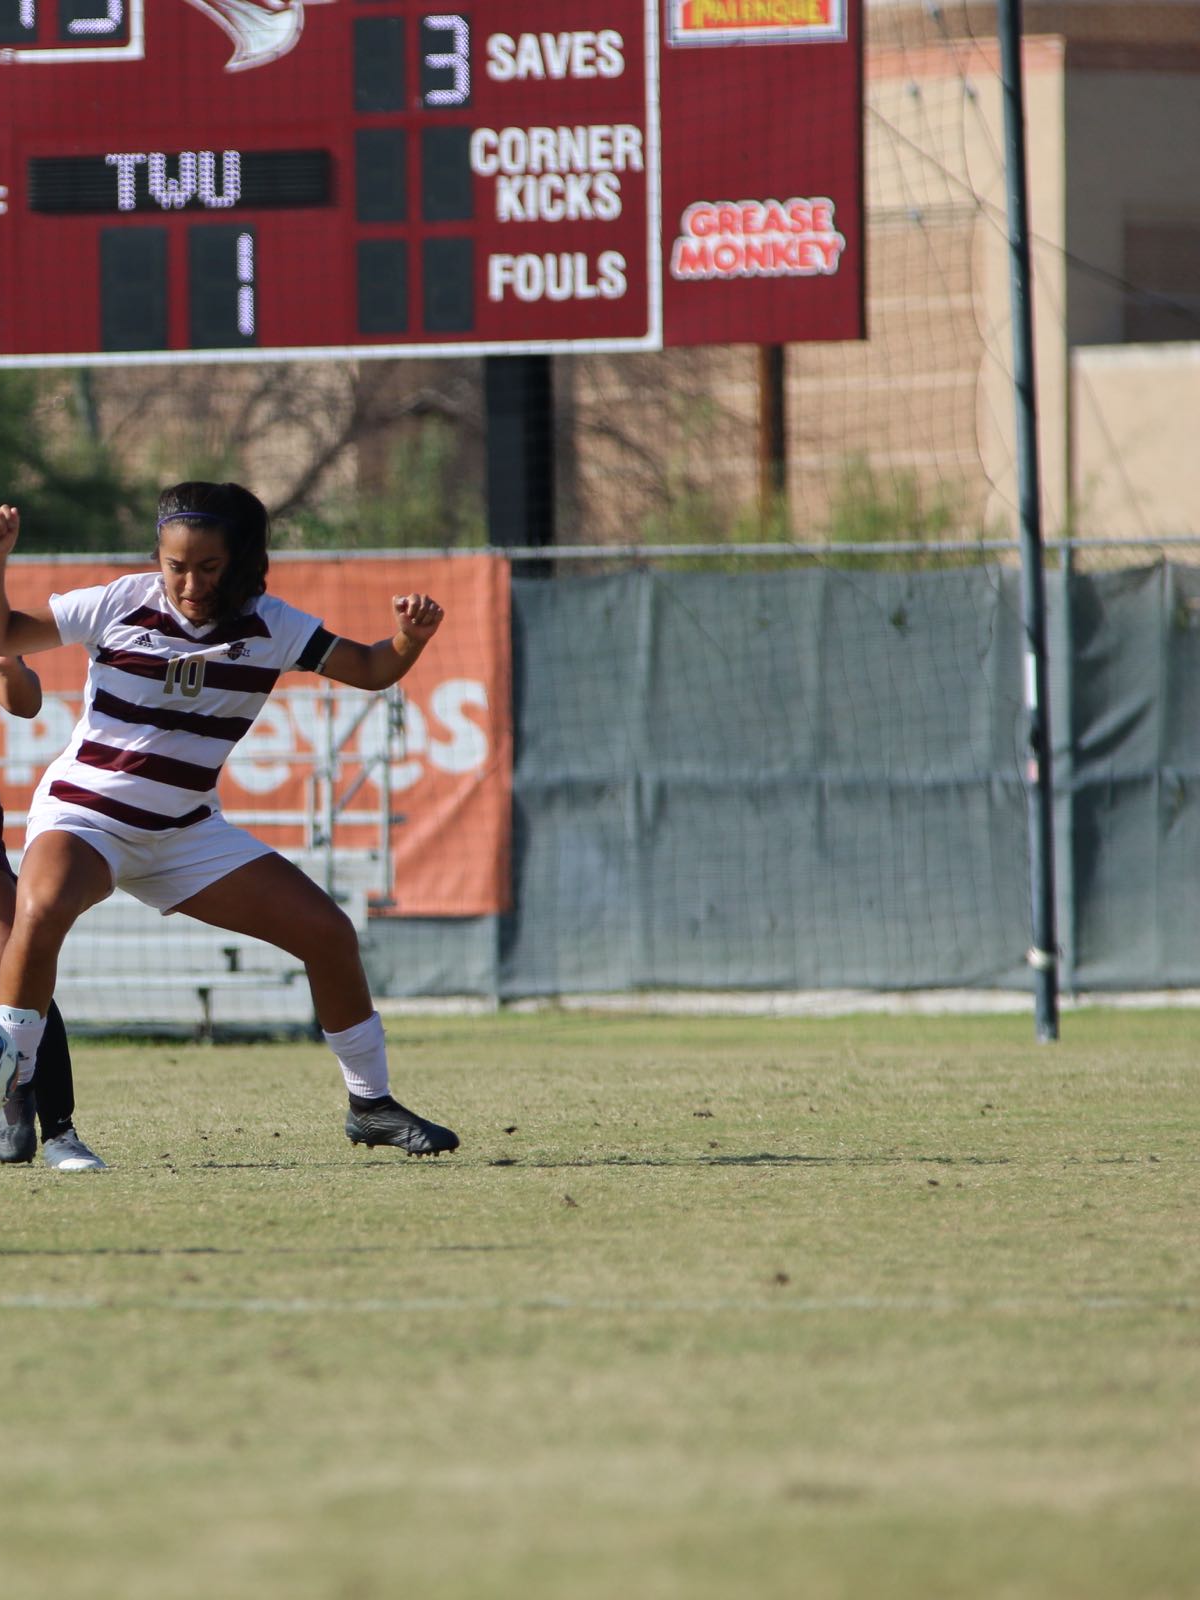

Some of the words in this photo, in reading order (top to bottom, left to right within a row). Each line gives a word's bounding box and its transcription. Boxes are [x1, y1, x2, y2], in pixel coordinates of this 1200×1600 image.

[423, 15, 470, 104] 3
[486, 30, 625, 81] SAVES
[470, 125, 644, 176] CORNER
[105, 150, 242, 211] TWU
[495, 171, 623, 222] KICKS
[690, 204, 830, 237] GREASE
[488, 250, 627, 301] FOULS
[678, 238, 842, 273] MONKEY
[236, 233, 255, 336] 1
[163, 654, 206, 697] 10
